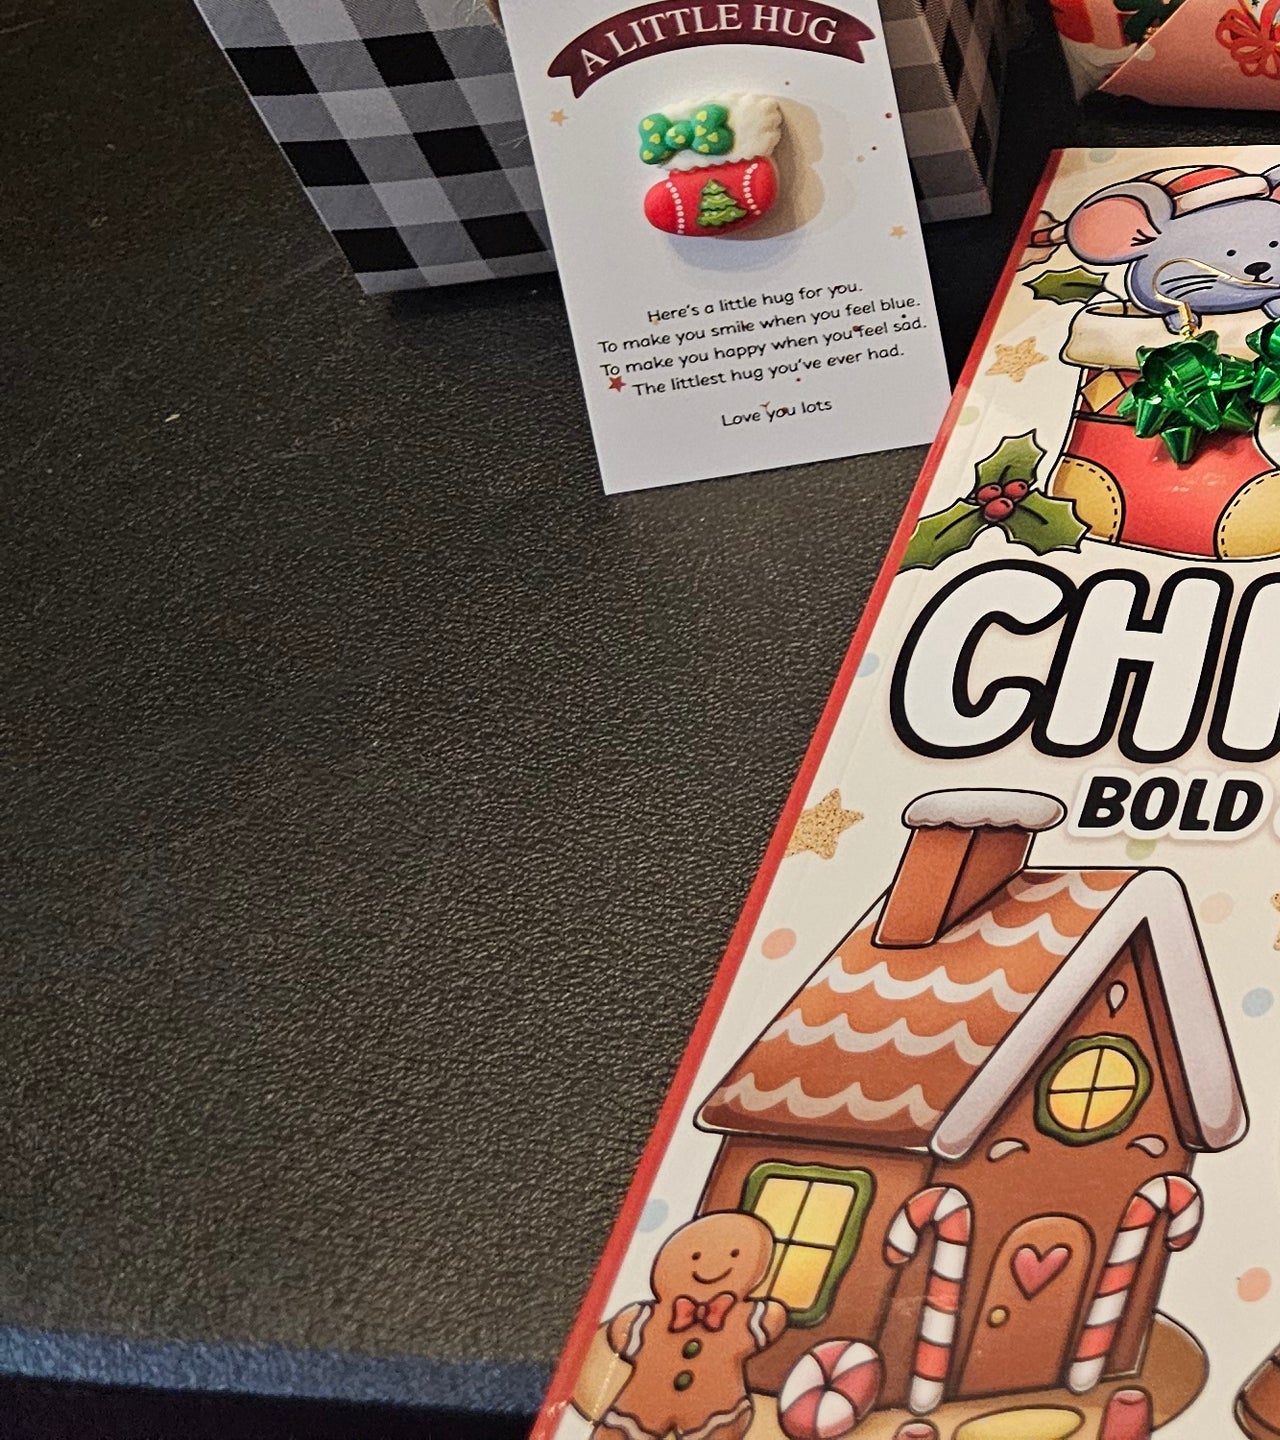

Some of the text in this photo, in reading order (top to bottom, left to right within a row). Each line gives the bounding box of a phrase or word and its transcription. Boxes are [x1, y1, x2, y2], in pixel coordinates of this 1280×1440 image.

[580, 3, 838, 77] A LITTLE HUG
[597, 297, 921, 353] To make you smile when you feel blue.
[648, 282, 863, 323] Here's a little hug for you.
[599, 317, 927, 376] To make you happy when you feel sad.
[632, 344, 905, 396] The littlest hug you've ever had.
[721, 400, 833, 427] Love you lots
[1078, 776, 1265, 832] BOLD
